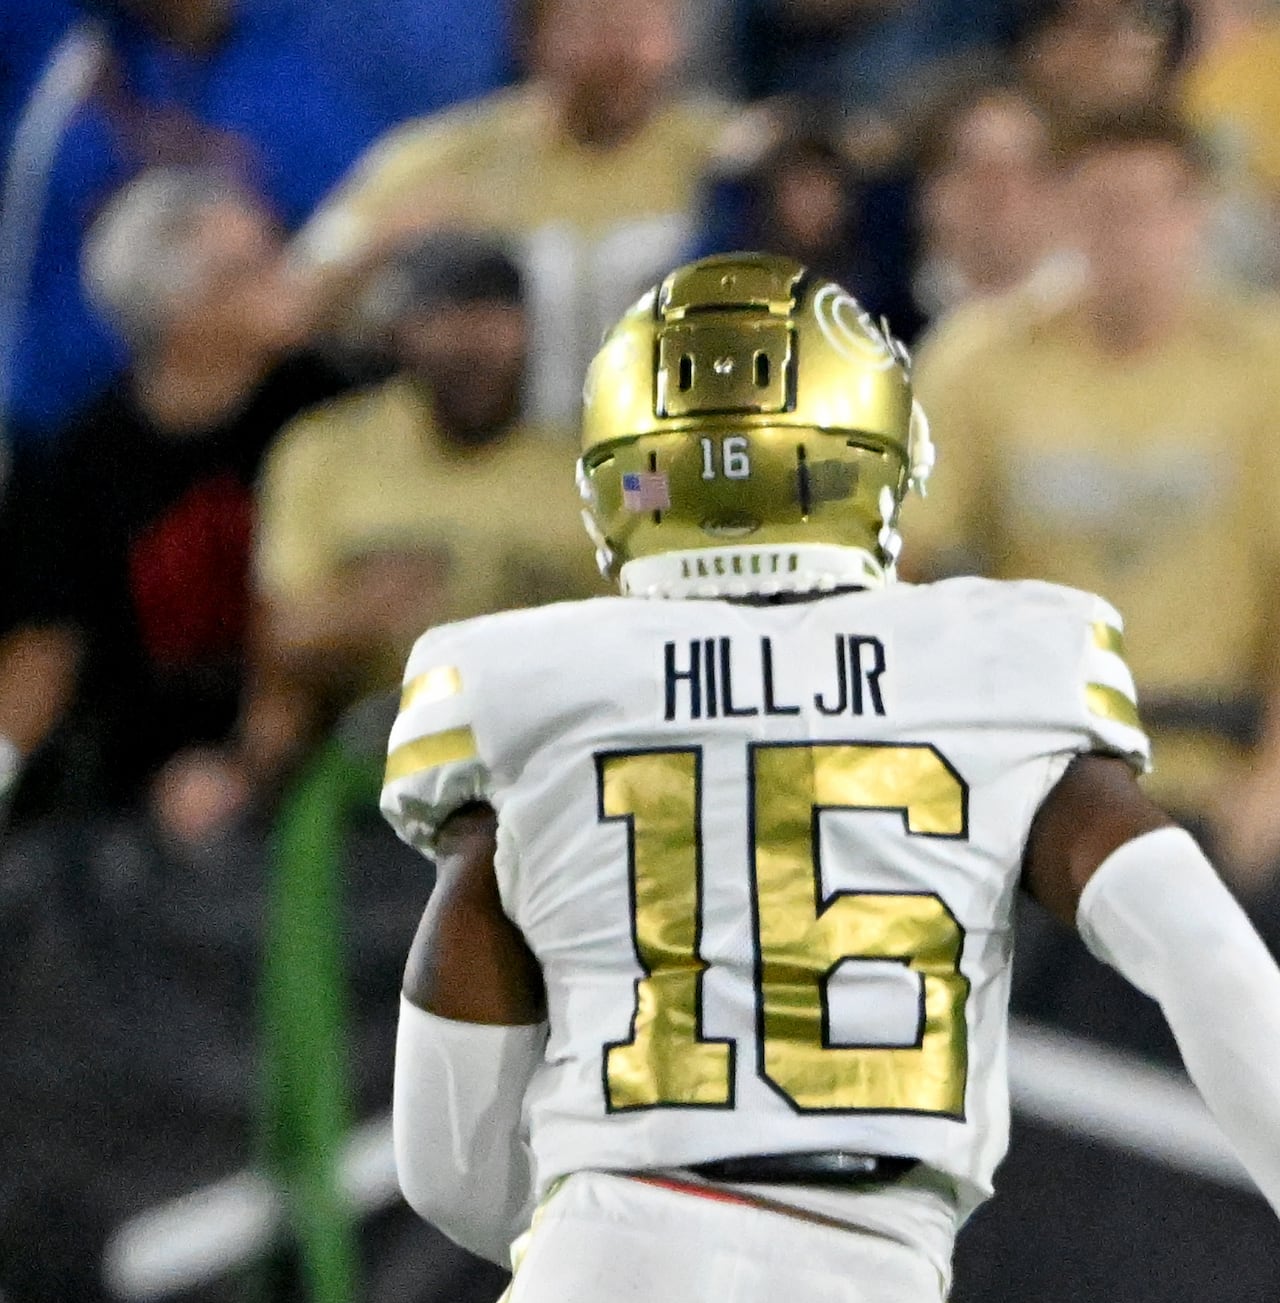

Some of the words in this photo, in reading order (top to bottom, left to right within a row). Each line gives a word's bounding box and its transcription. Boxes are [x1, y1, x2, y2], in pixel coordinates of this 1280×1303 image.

[700, 436, 750, 480] 16
[663, 635, 801, 720] HILL
[813, 633, 887, 716] JR
[593, 739, 970, 1122] 16
